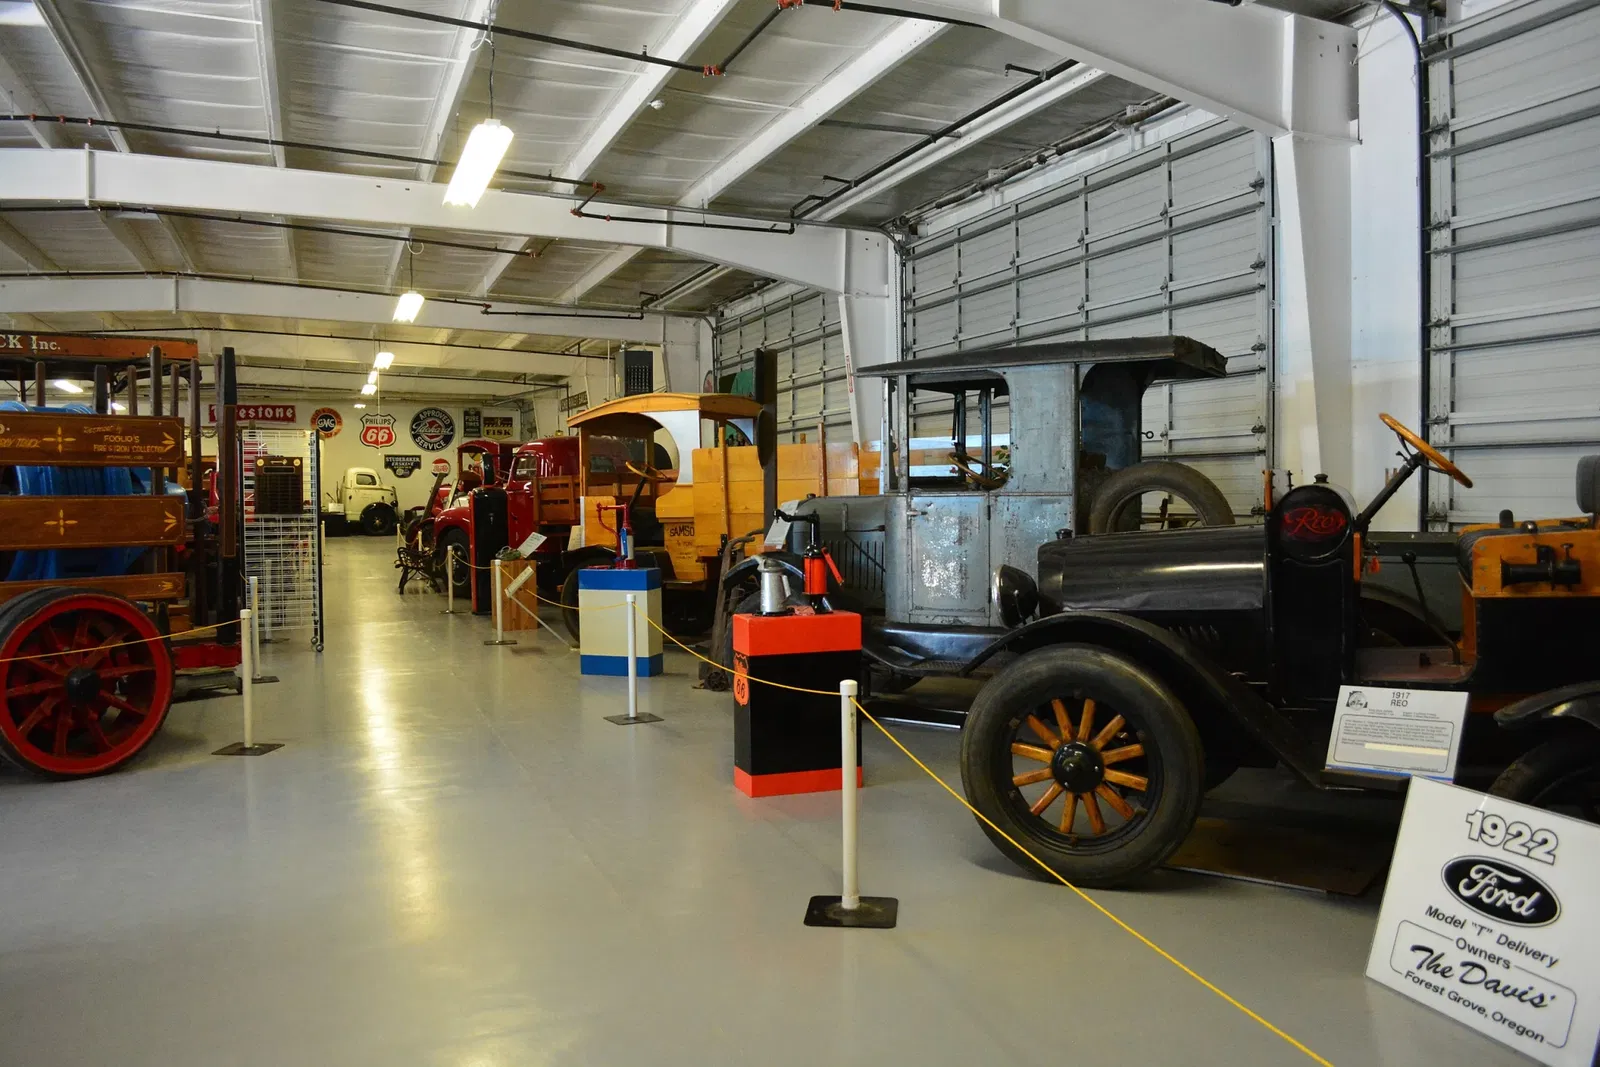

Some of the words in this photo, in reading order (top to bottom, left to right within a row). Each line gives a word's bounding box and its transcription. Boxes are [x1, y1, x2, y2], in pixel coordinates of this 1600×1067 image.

[30, 335, 61, 350] Inc.
[211, 405, 293, 418] Festone
[419, 409, 450, 425] APPROVED
[317, 418, 335, 428] GMC
[411, 420, 453, 434] Packard
[366, 428, 390, 442] 66
[415, 436, 447, 450] SERVICE
[669, 524, 694, 537] SAMSO
[1391, 691, 1411, 699] 1917
[1390, 699, 1409, 707] REO
[1465, 809, 1559, 866] 1922
[1458, 864, 1541, 917] Ford
[1425, 905, 1467, 929] Model
[1496, 933, 1559, 968] Delivery
[1455, 937, 1511, 969] Owners
[1410, 944, 1454, 979] The
[1404, 970, 1445, 995] Forest
[1447, 990, 1489, 1018] Grove,
[1491, 1011, 1545, 1043] Oregon
